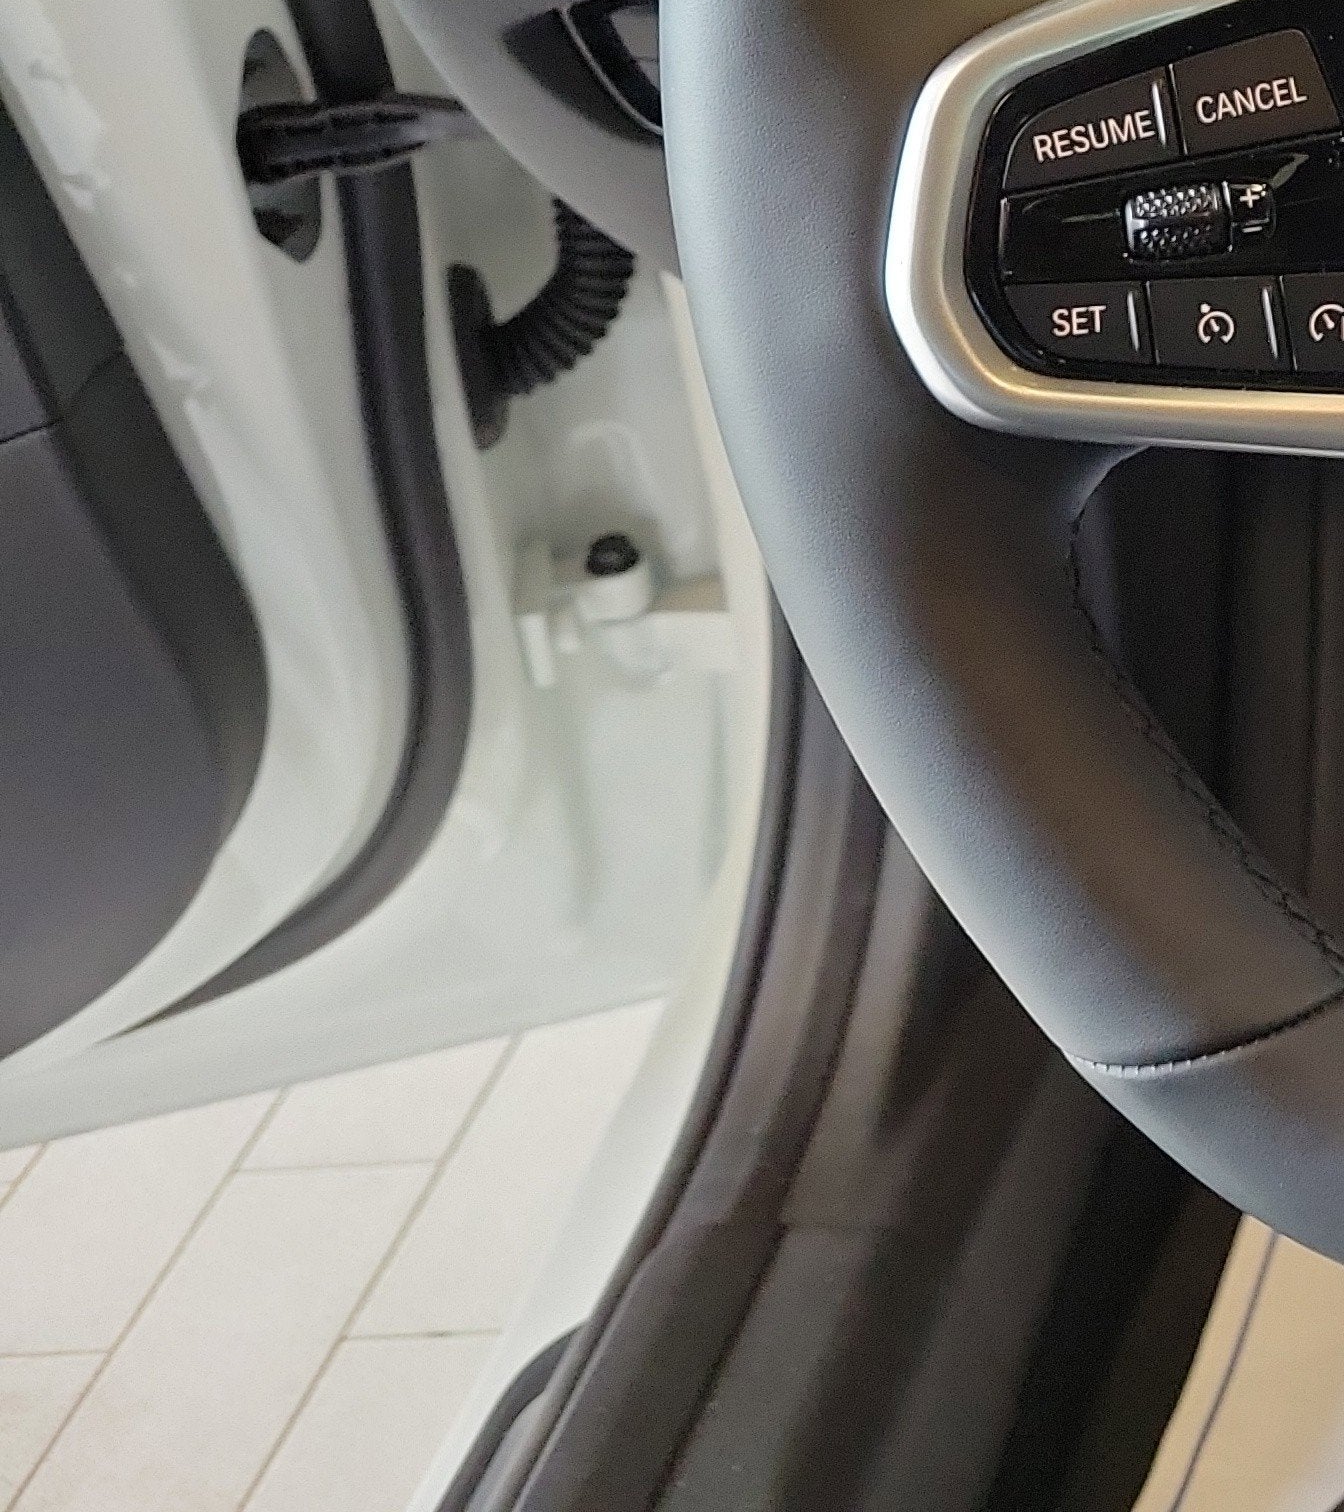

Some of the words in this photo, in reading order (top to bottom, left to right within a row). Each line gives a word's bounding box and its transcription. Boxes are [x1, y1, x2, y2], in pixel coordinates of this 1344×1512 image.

[1196, 78, 1307, 125] CANCEL
[1033, 109, 1157, 163] RESUME
[1052, 304, 1107, 337] SET
